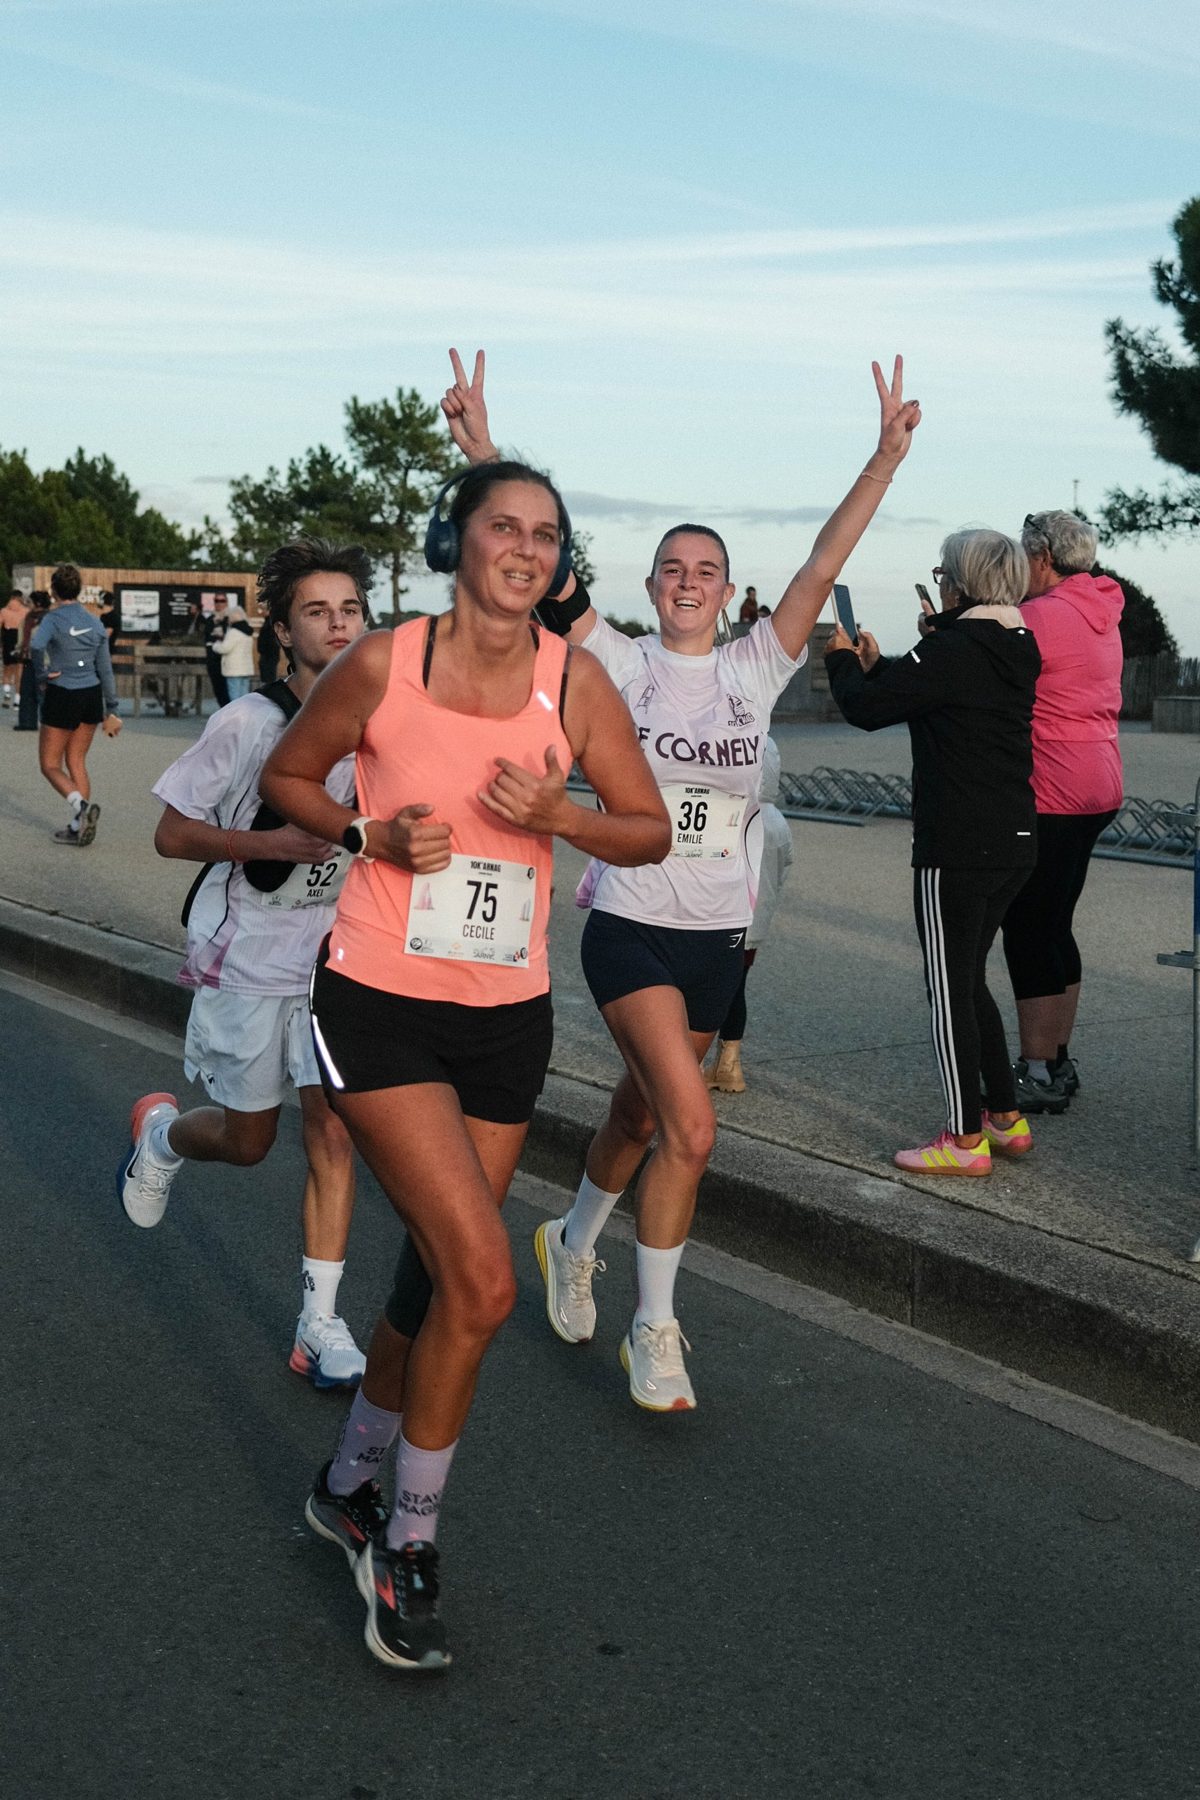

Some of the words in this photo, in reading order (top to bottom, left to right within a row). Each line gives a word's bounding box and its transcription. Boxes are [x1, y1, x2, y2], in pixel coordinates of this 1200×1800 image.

[655, 733, 759, 767] CORNELY
[678, 801, 708, 832] 36
[677, 833, 703, 844] EMILIE
[306, 862, 338, 887] 52
[307, 889, 324, 897] AXEL
[466, 880, 498, 923] 75
[462, 924, 495, 941] CECILE
